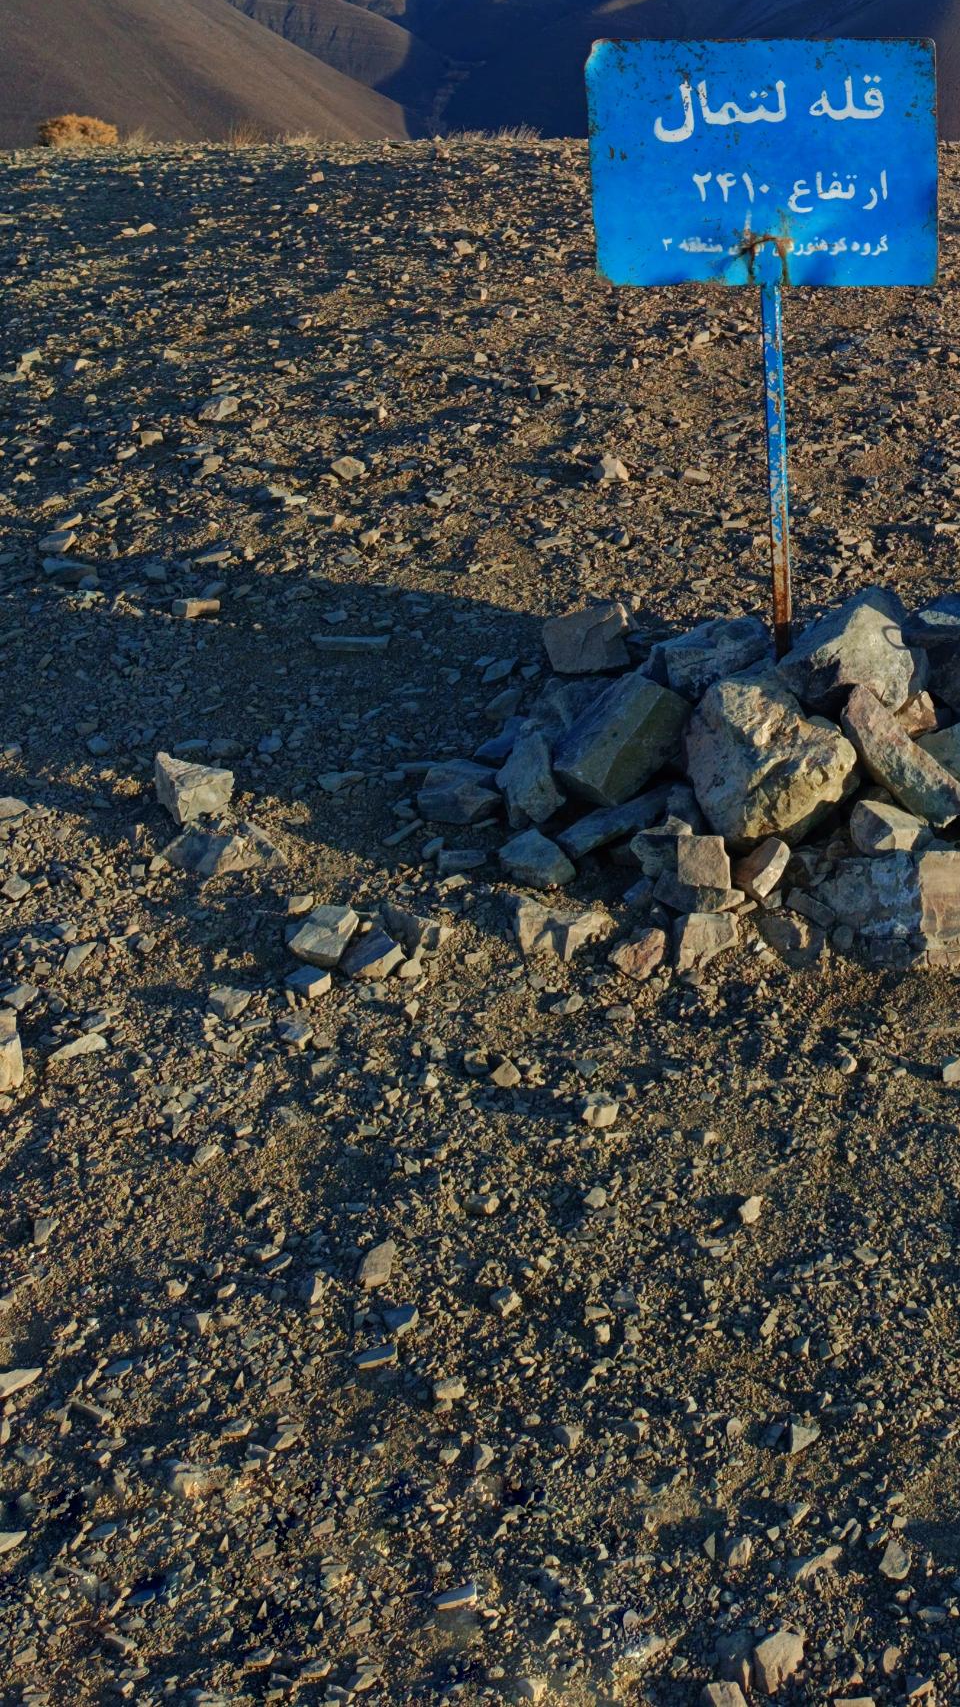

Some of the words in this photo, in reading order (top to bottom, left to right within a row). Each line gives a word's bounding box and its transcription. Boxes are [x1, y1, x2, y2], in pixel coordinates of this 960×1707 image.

[653, 79, 787, 143] لتمال
[809, 74, 885, 121] قله
[692, 171, 770, 204] ۲۴۱۰
[787, 169, 888, 214] ارتفاع
[851, 234, 889, 256] گروه
